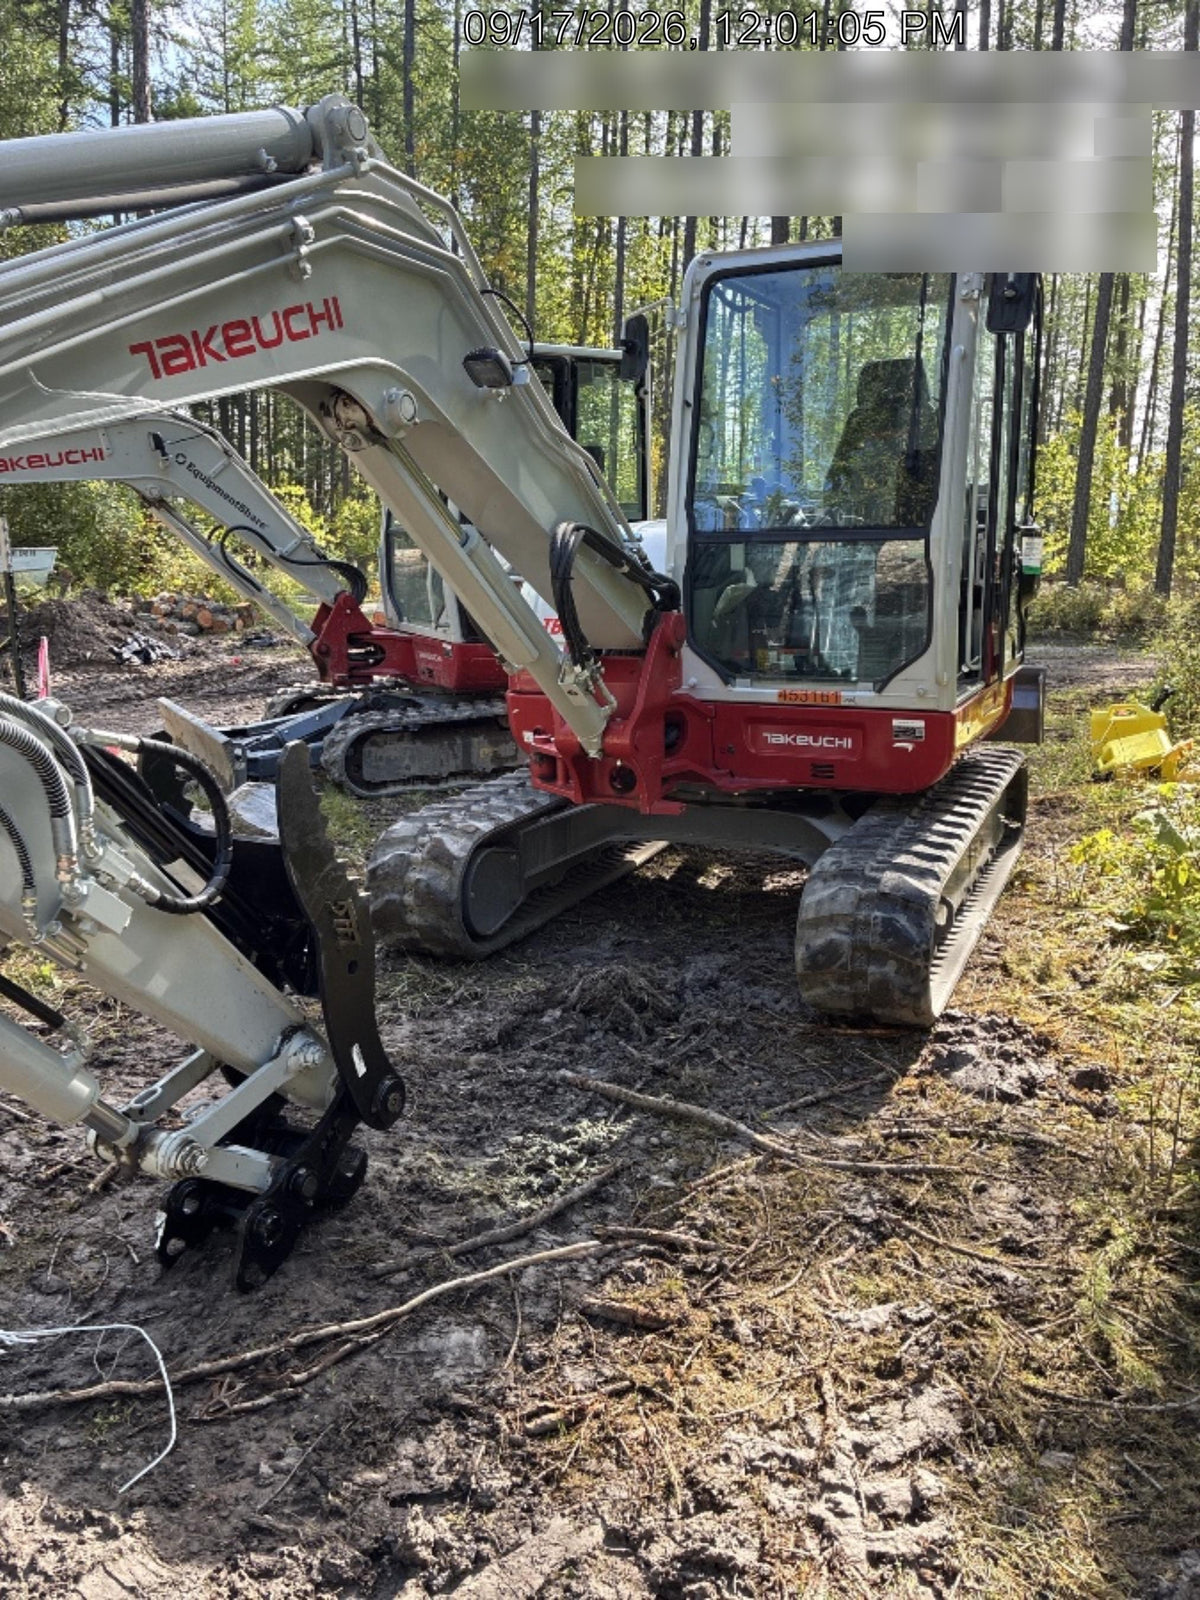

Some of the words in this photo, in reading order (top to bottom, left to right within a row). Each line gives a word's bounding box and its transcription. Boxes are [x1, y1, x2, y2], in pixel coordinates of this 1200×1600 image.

[128, 296, 344, 380] TAKEUCHI
[0, 447, 105, 473] AKEUCHI
[762, 731, 853, 750] TAKEUCHI
